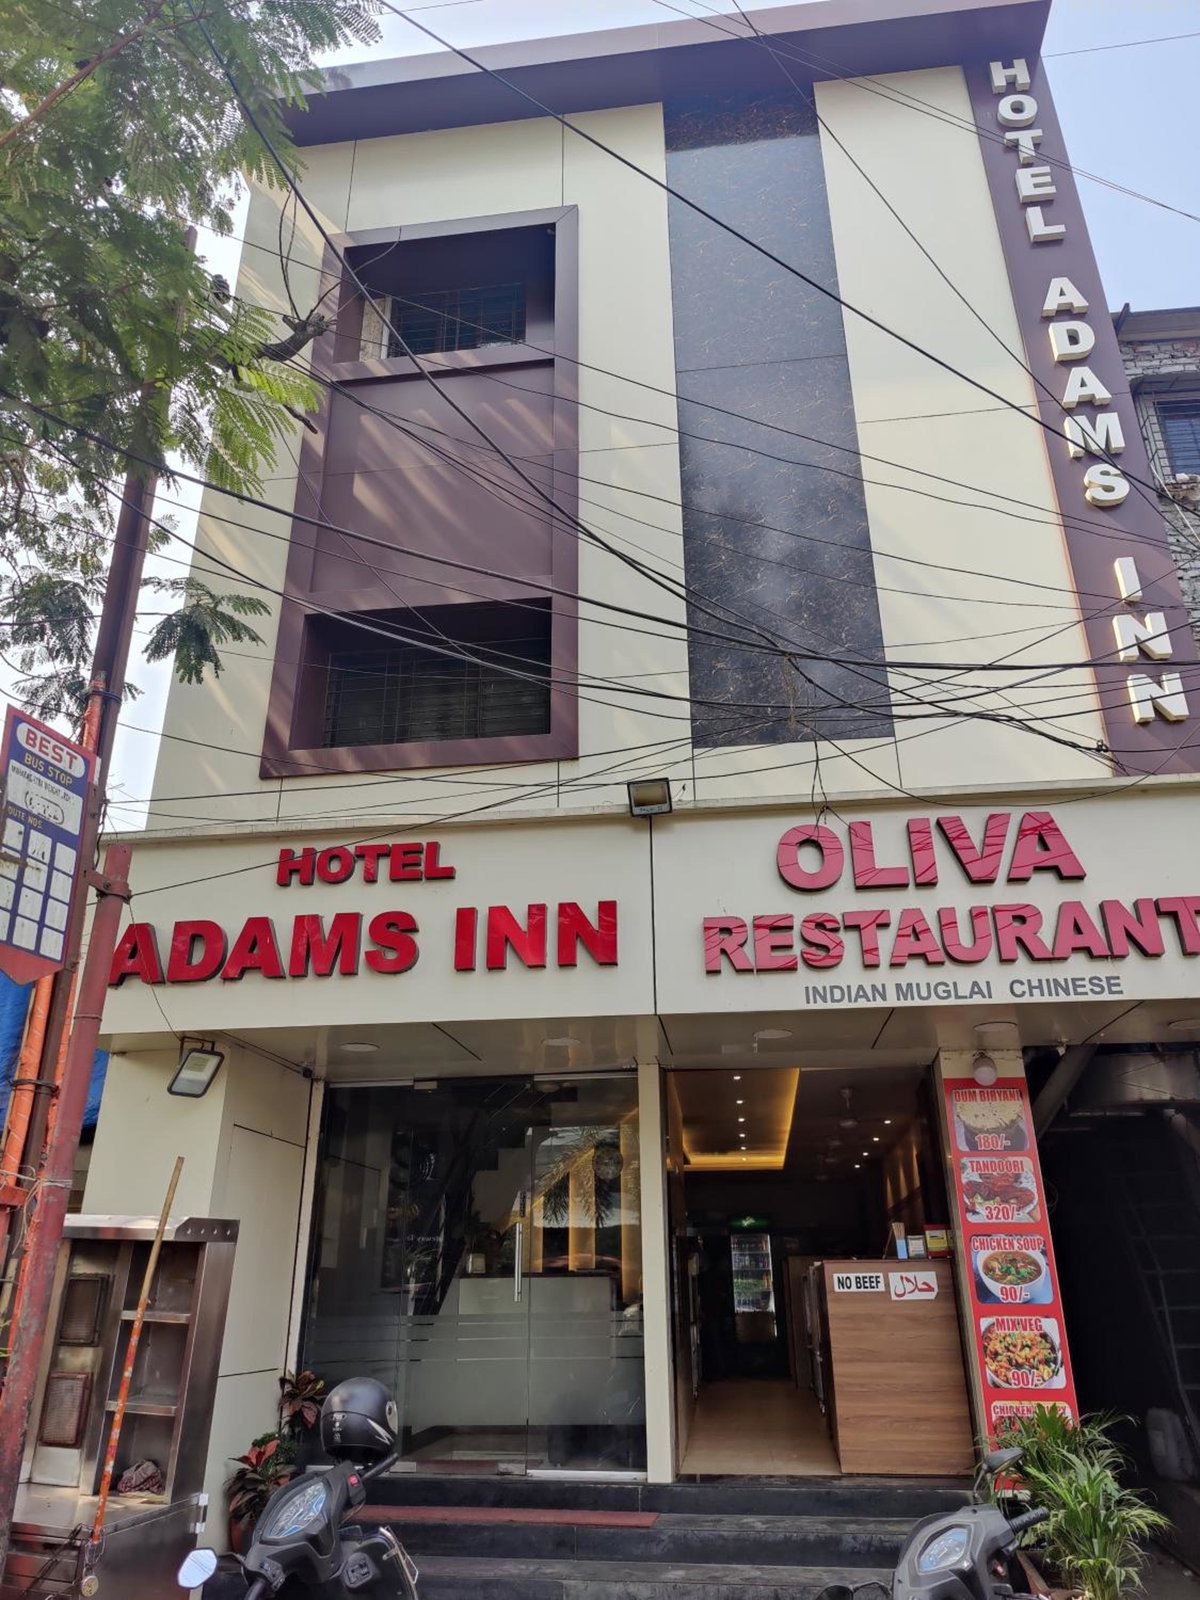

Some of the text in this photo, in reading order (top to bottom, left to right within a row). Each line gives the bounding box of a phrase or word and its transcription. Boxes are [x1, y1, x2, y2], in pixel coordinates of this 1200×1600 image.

[989, 58, 1190, 723] HOTEL ADAMS INN
[25, 728, 78, 770] BEST
[24, 753, 44, 772] BUS
[47, 766, 73, 786] STOP
[776, 811, 1087, 892] OLIVA
[276, 841, 456, 887] HOTEL
[107, 900, 618, 987] ADAMS INN
[702, 895, 1200, 972] RESTAURANT
[804, 975, 1124, 1005] INDIAN MUGLAI CHINESE
[954, 1090, 978, 1102] DUM
[975, 1134, 1011, 1150] 180/-
[969, 1160, 1024, 1173] TANDOORI
[985, 1205, 1021, 1220] 320/-
[972, 1237, 1043, 1250] CHICKEN SOUP
[837, 1275, 881, 1290] NO BEEF
[894, 1273, 935, 1298] حلال
[1000, 1286, 1029, 1301] 90/-
[995, 1318, 1043, 1331] MIX VEG
[1012, 1370, 1042, 1387] 90/-
